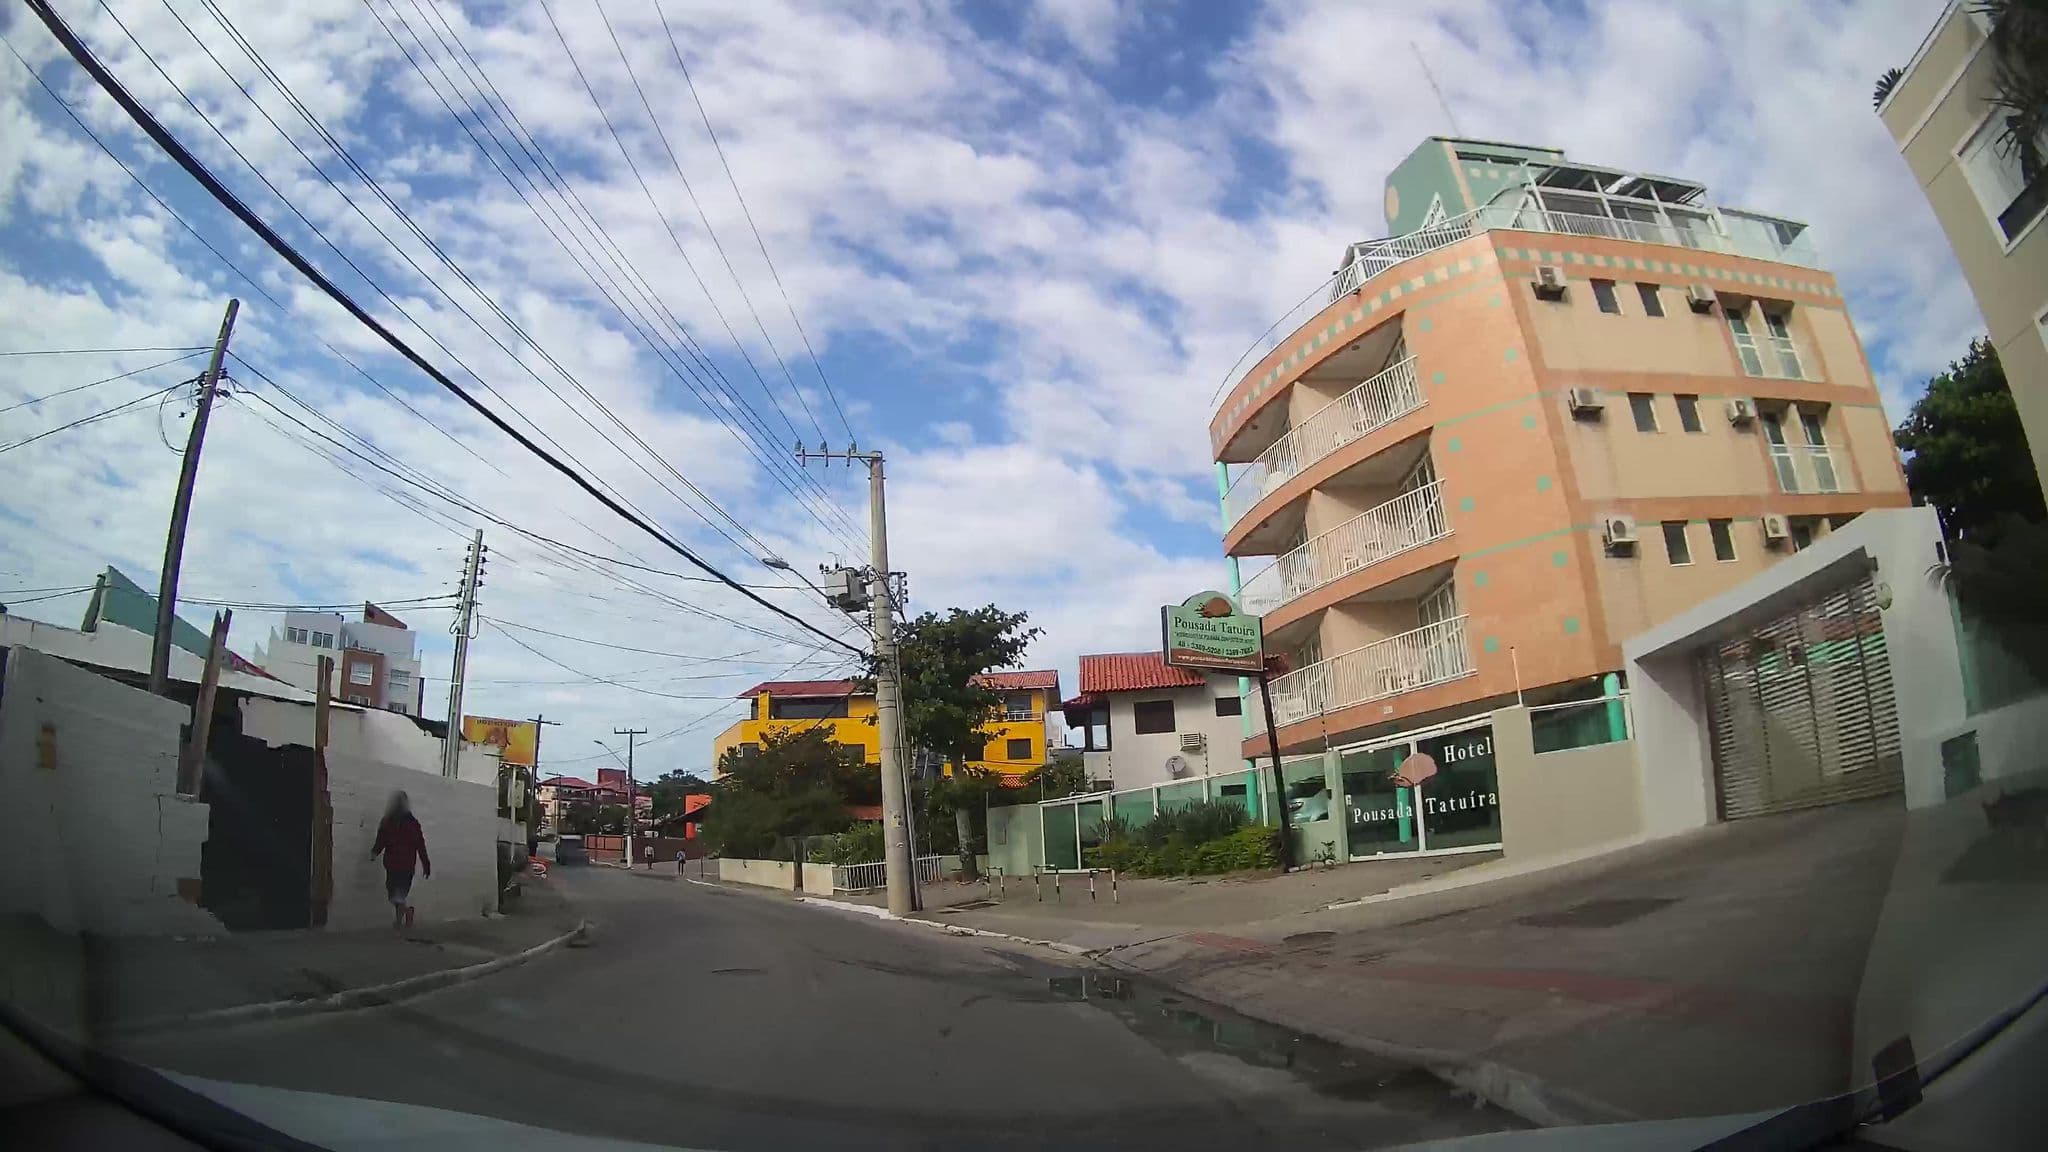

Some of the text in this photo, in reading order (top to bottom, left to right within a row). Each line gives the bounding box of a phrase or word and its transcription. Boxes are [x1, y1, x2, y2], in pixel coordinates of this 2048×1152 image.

[1175, 616, 1216, 632] Pousada
[1443, 736, 1493, 763] Hotel
[1354, 791, 1497, 824] Pousada Tatuíra
